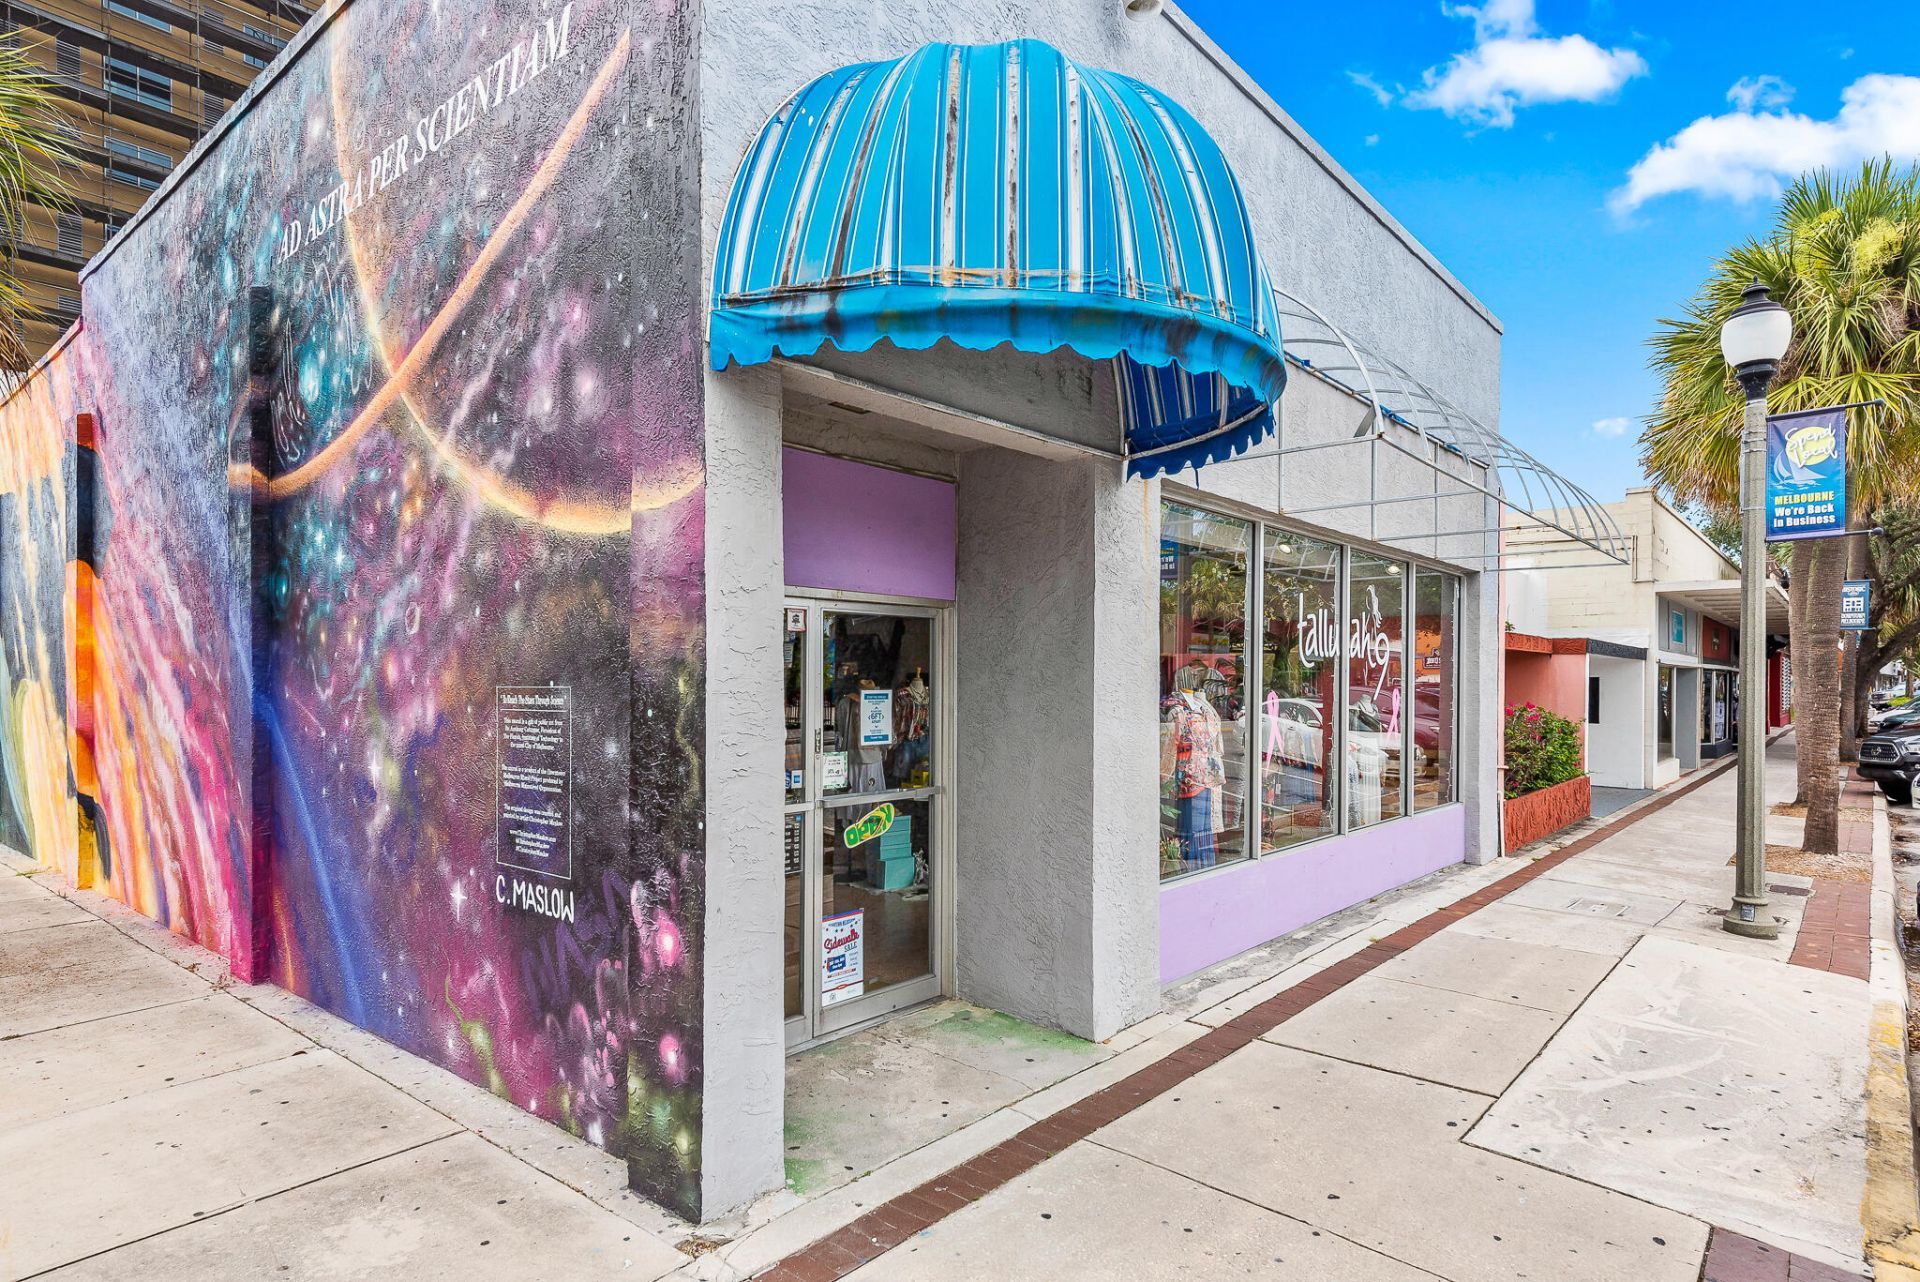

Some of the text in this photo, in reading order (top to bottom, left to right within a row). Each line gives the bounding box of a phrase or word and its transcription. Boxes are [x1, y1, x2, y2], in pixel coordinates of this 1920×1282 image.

[277, 2, 573, 265] AD ASTRA PER SCIENTIAM
[1785, 423, 1836, 453] Spend
[1793, 441, 1838, 468] Local
[1774, 490, 1835, 505] MELBOURNE
[1774, 502, 1835, 517] We're Back
[1786, 515, 1836, 527] Business
[1297, 592, 1377, 669] talluah
[845, 803, 893, 846] OPEN
[496, 874, 575, 924] C. MASLOW
[824, 927, 860, 954] Sidewalk
[844, 942, 858, 953] SALE
